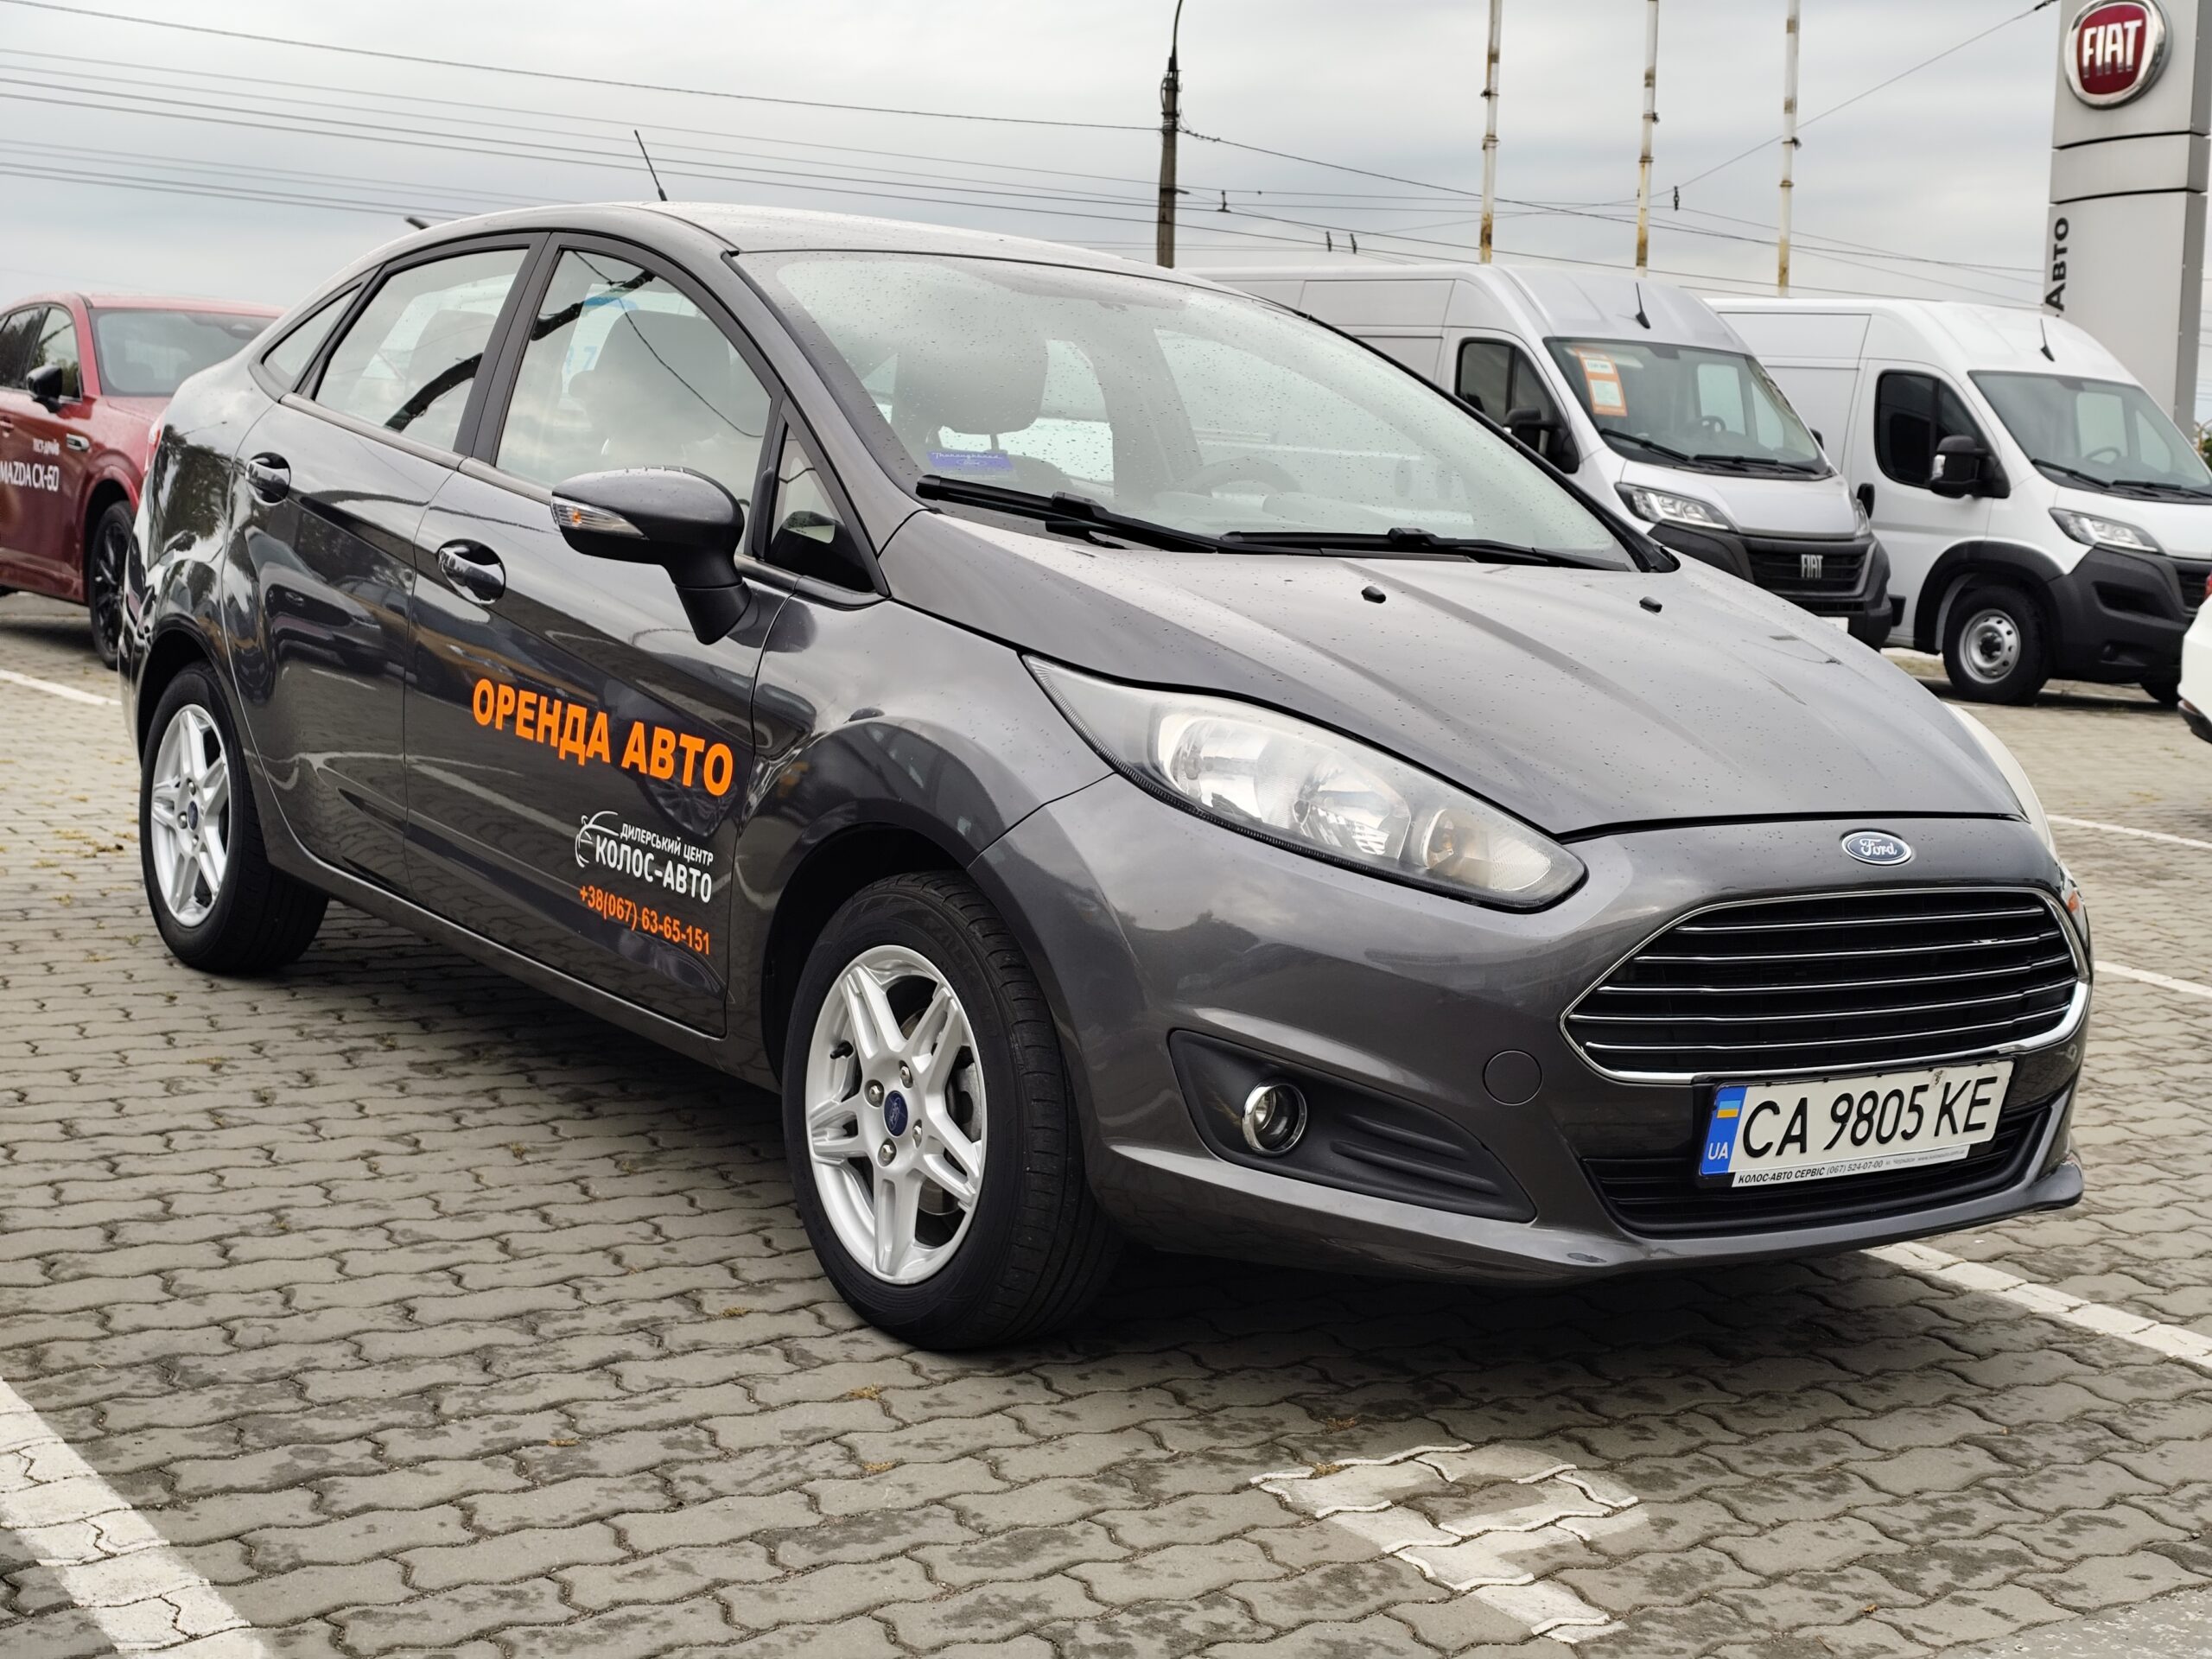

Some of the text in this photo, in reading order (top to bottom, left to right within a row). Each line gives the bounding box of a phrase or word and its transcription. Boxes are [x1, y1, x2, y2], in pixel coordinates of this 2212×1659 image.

[2082, 19, 2143, 79] FIAT
[32, 462, 60, 492] CX-60
[1801, 554, 1823, 578] FIAT
[473, 677, 734, 797] ОРЕНДА АВТО
[620, 823, 714, 867] ДИЛЕРСЬКИЙ ЦЕНТР
[1859, 838, 1897, 856] Ford
[595, 835, 712, 903] КОЛОС-АВТО
[579, 885, 710, 955] +38(067) 63-65-151
[1823, 1084, 1929, 1151] 9805
[1707, 1142, 1729, 1160] UA
[1738, 1170, 1793, 1185] КОЛОС-АВТО
[1794, 1166, 1825, 1179] СЕРВІС
[1826, 1165, 1847, 1176] (067)
[1847, 1160, 1884, 1173] 524-07-00
